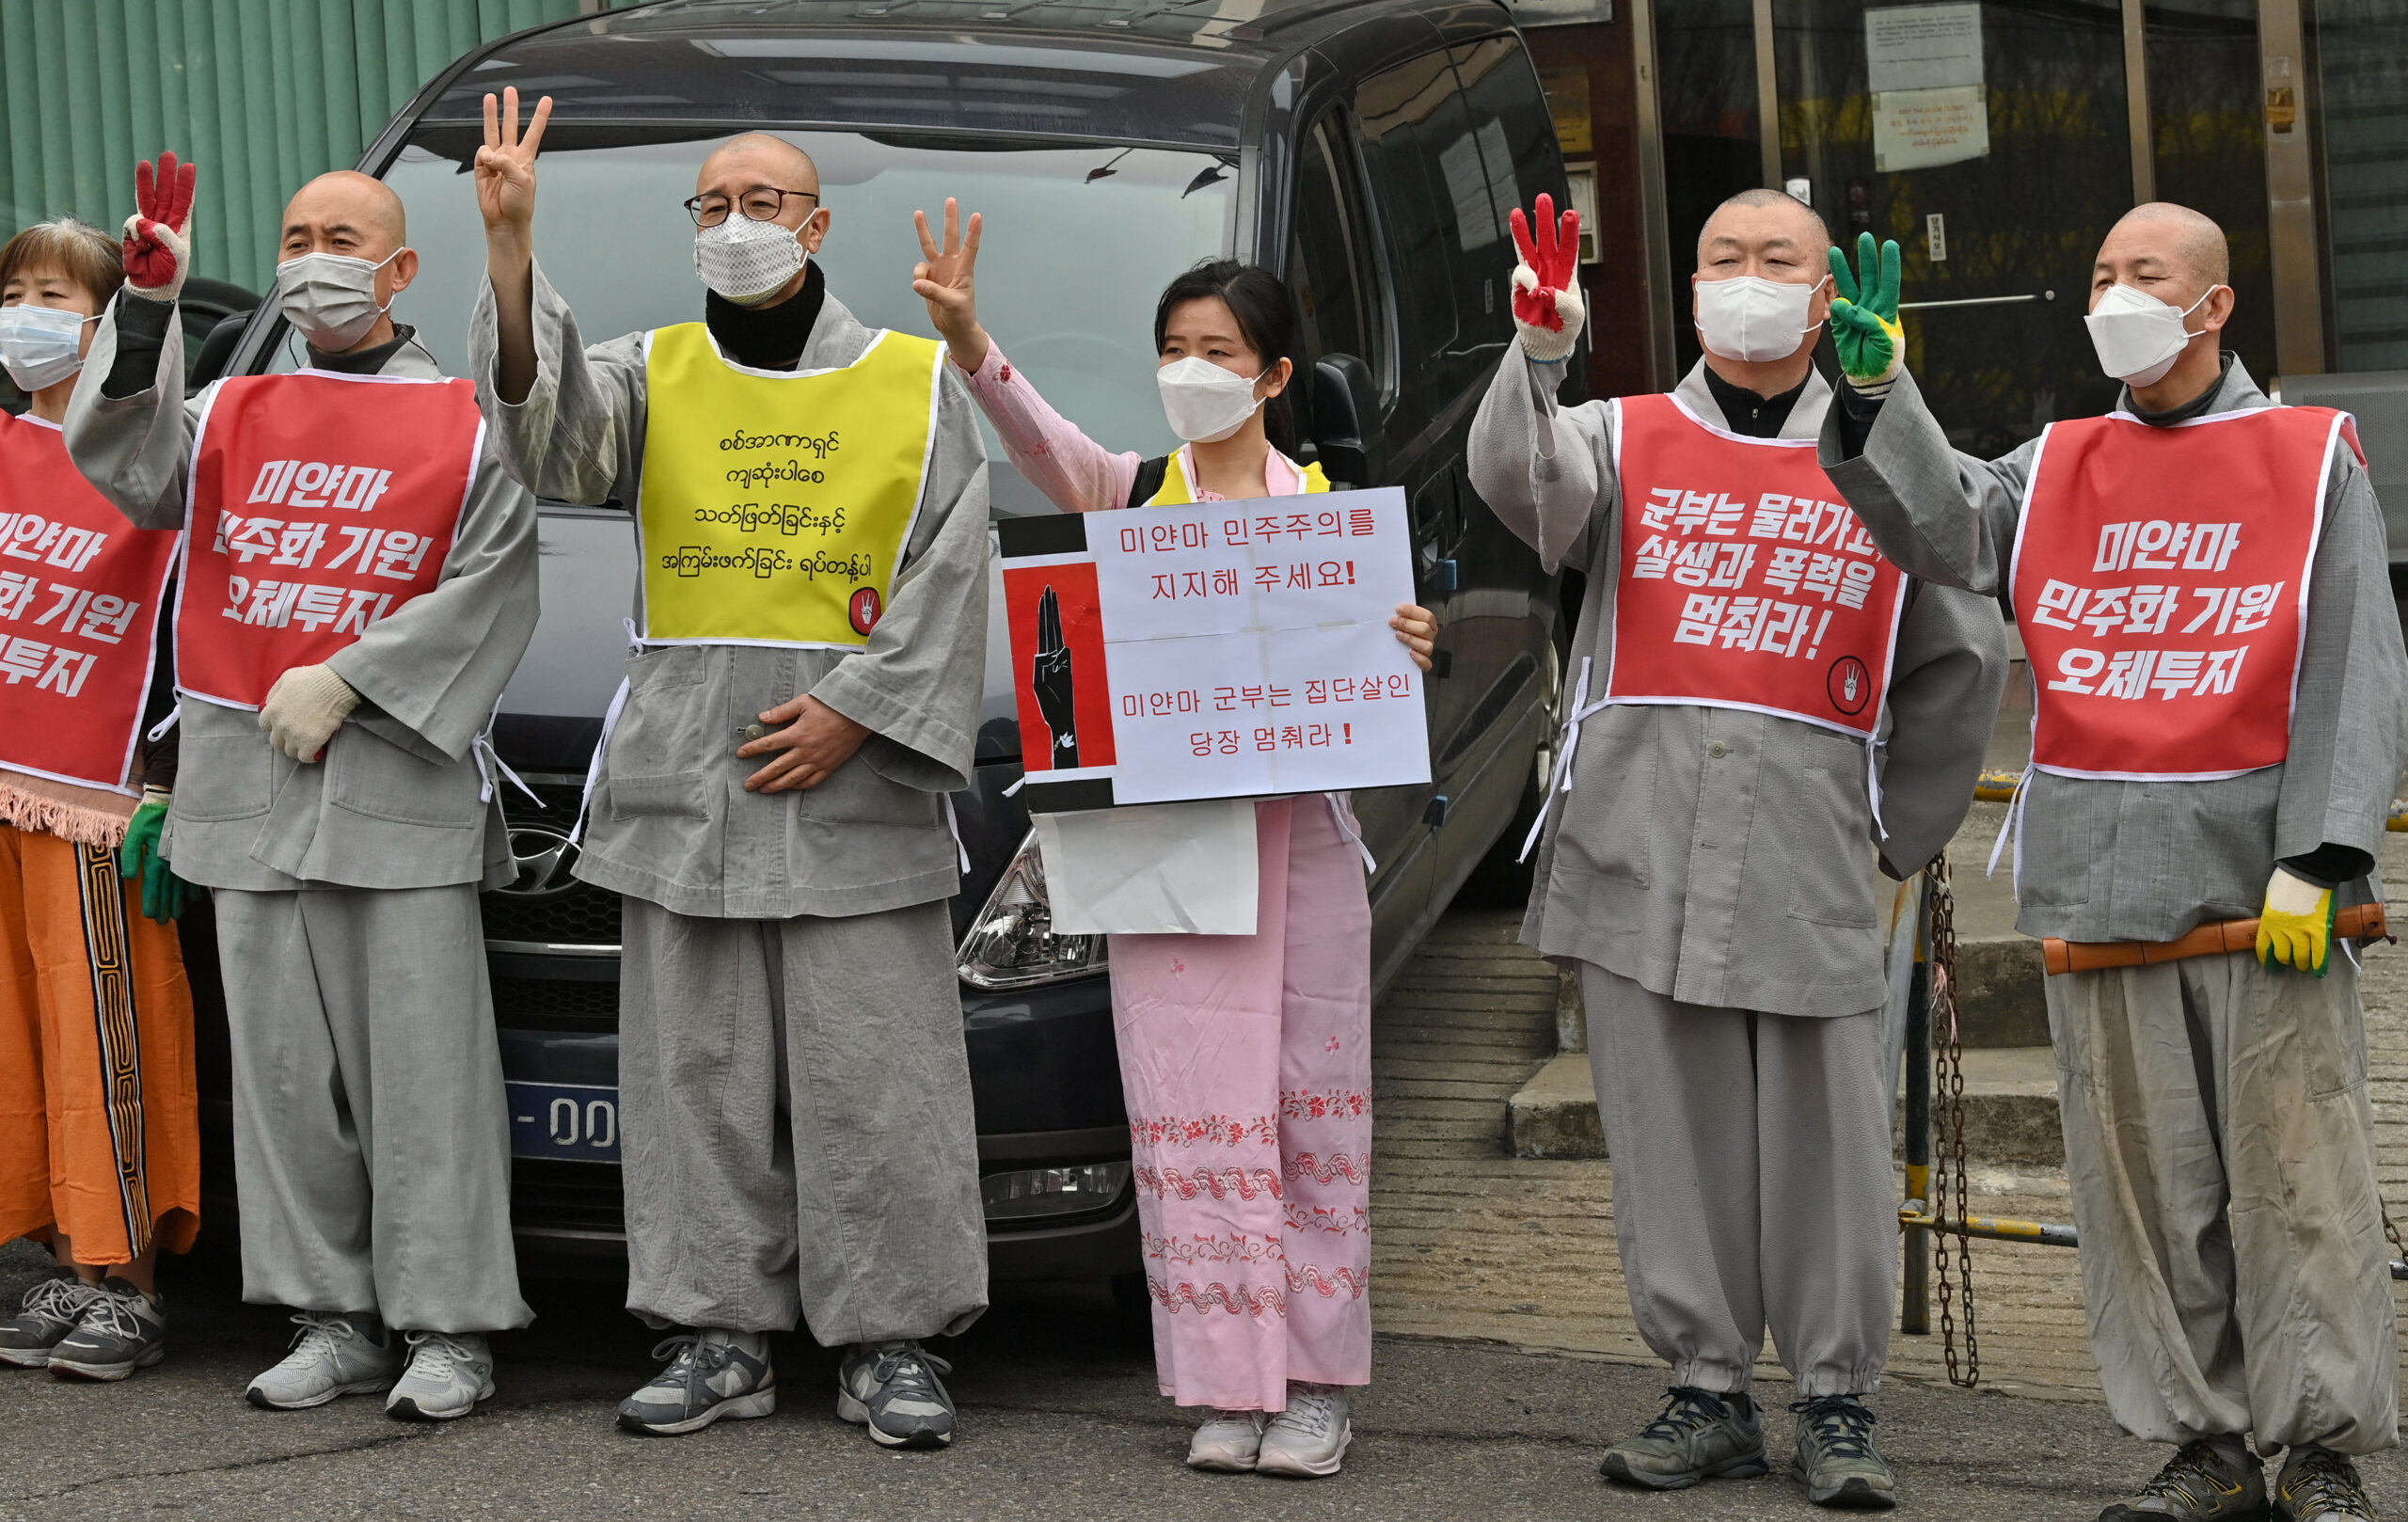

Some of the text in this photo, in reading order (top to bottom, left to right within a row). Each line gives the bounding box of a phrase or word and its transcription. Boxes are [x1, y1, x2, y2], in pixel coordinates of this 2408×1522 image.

[246, 460, 392, 513] 미얀마
[726, 460, 824, 489] ကျဆုံးပါစေ
[1119, 508, 1375, 554] 미얀마 민주주의를
[1640, 487, 1746, 536] 군부는
[325, 526, 434, 580] 기원
[1632, 534, 1876, 610] 살생과 폭력을
[2092, 520, 2242, 573] 미얀마
[222, 574, 393, 636] 오체투지
[1150, 561, 1355, 600] 지지해 주세요!
[33, 582, 140, 644] 기원
[1673, 593, 1833, 660] 멈춰라!
[2032, 579, 2285, 638] 민주화 기원
[1122, 674, 1411, 718] 미얀마 군부는 집단살인
[2047, 645, 2249, 701] 오체투지
[1190, 730, 1240, 756] 당장
[1254, 722, 1332, 751] 멈춰라
